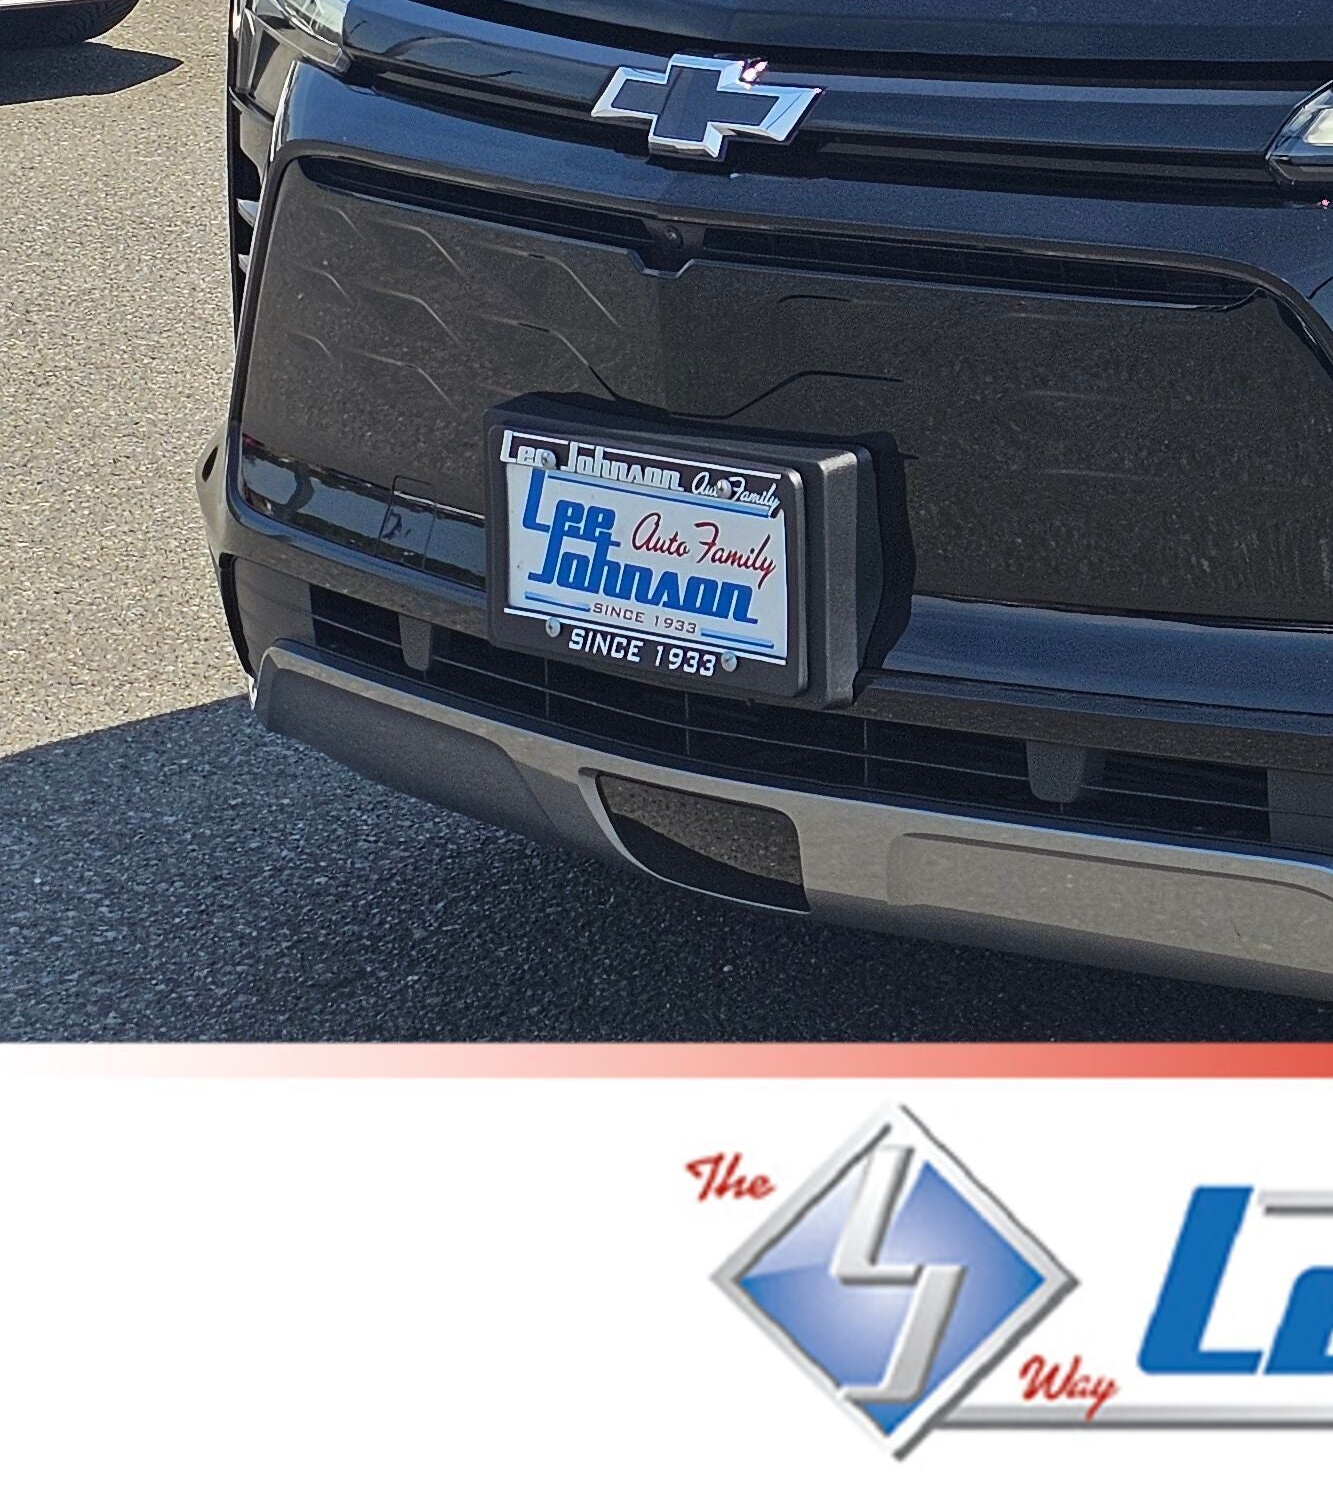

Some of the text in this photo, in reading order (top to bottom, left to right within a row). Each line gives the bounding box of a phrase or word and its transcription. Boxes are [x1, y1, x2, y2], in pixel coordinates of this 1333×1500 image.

[522, 469, 620, 547] Lee
[561, 441, 684, 491] Johnson
[729, 476, 780, 519] Family
[528, 533, 758, 624] Johnson
[631, 512, 777, 590] Auto Family
[567, 628, 717, 677] SINCE 1933
[592, 602, 697, 635] SINCE 1933
